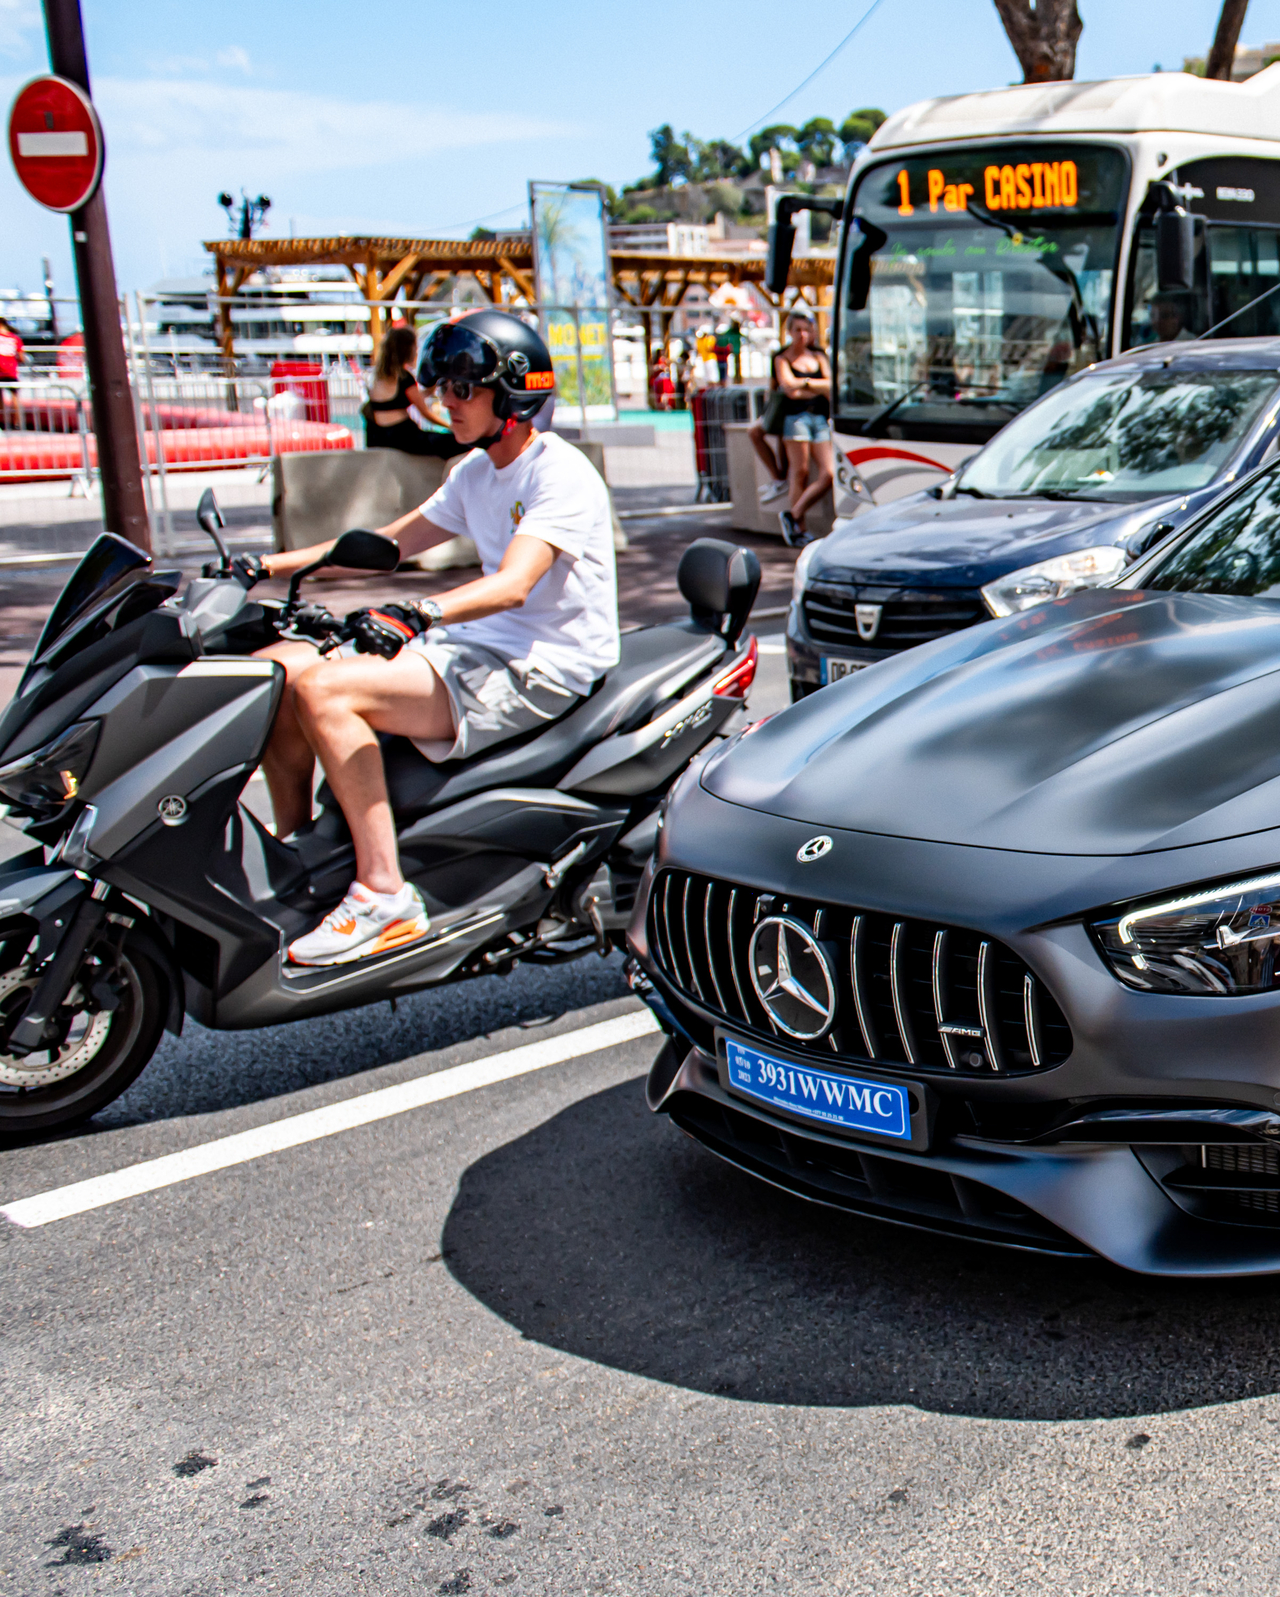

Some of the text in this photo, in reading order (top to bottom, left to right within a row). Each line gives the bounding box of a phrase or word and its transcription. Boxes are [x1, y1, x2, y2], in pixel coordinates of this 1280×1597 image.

[897, 160, 1078, 216] 1 Par CASINO
[951, 1027, 981, 1037] AMG
[757, 1059, 893, 1117] 3931WWMC
